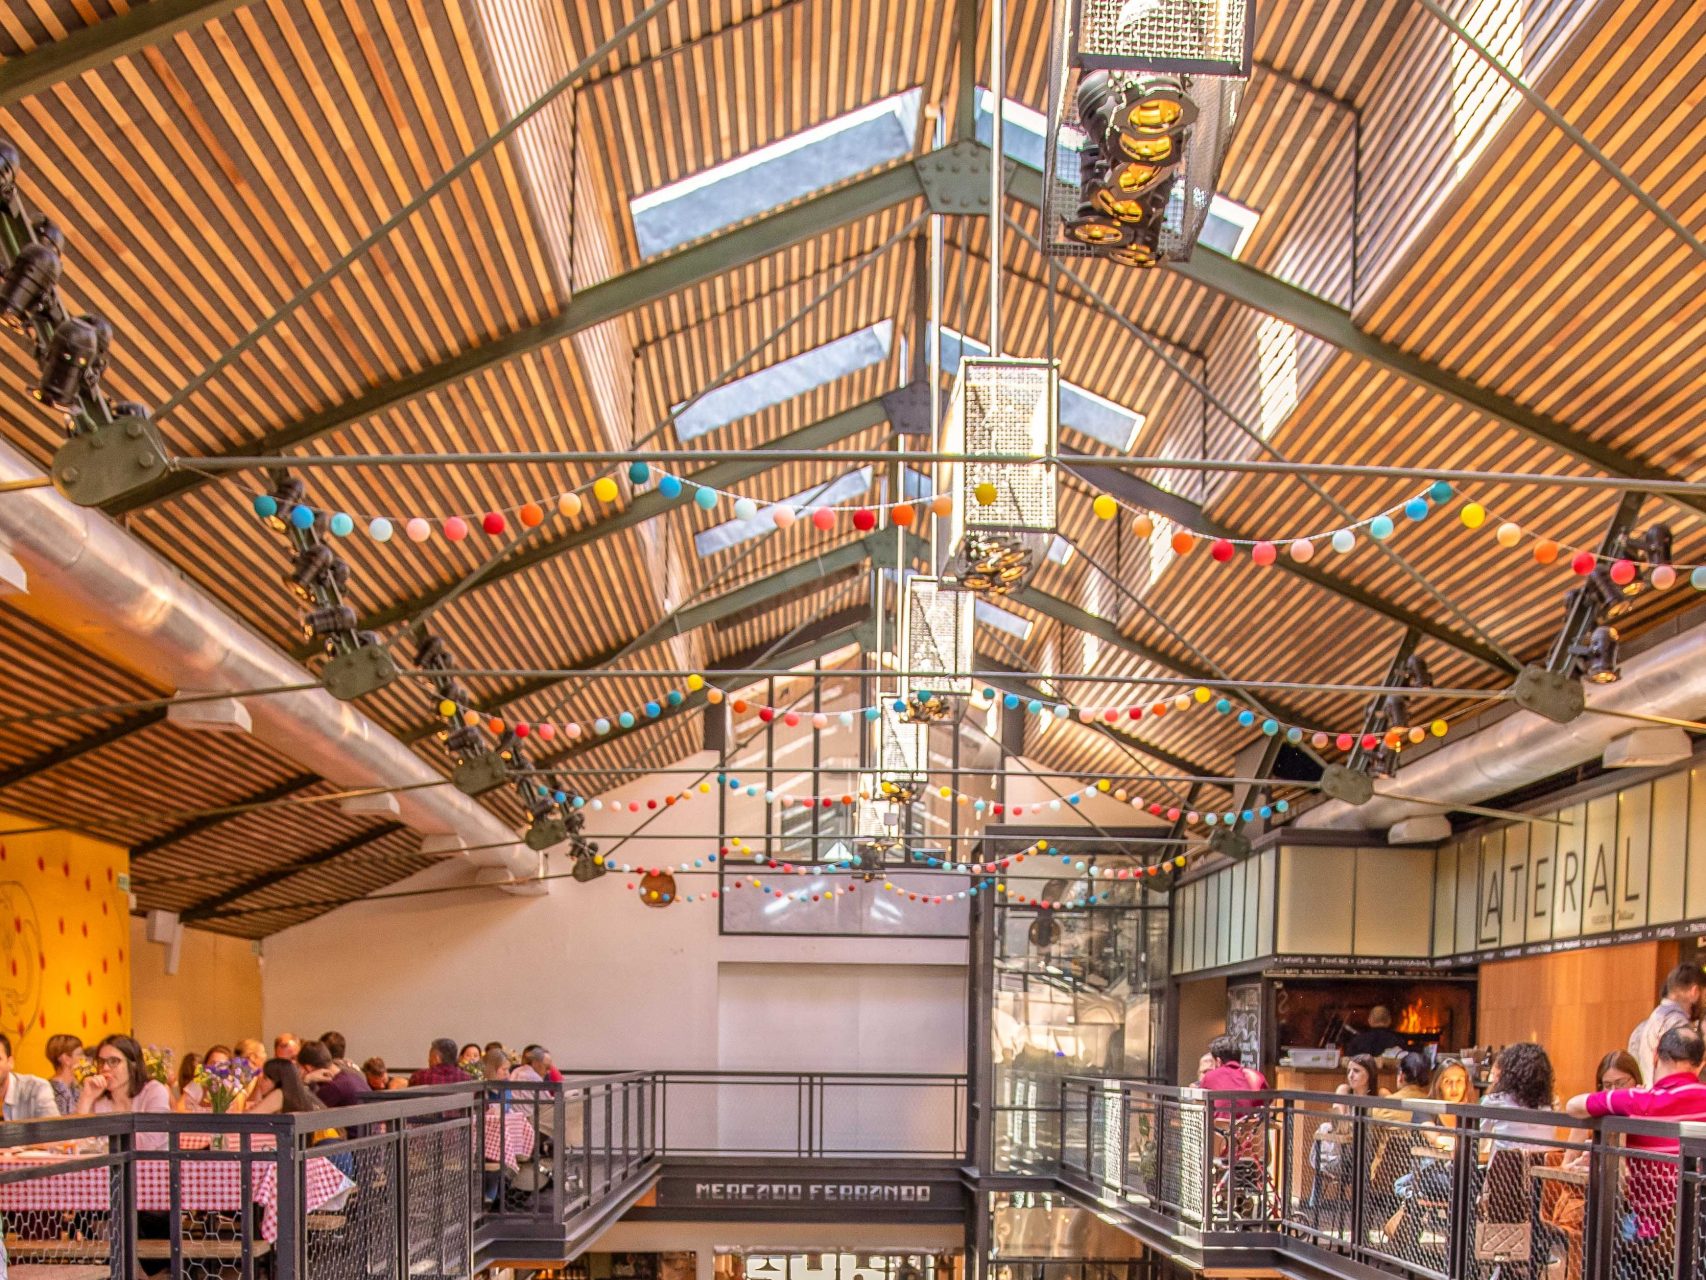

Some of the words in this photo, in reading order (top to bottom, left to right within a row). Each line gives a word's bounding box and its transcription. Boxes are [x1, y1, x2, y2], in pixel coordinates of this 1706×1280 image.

[1479, 836, 1640, 944] LATERAL
[695, 1183, 802, 1201] MERCADO
[810, 1184, 931, 1202] FERRANDO
